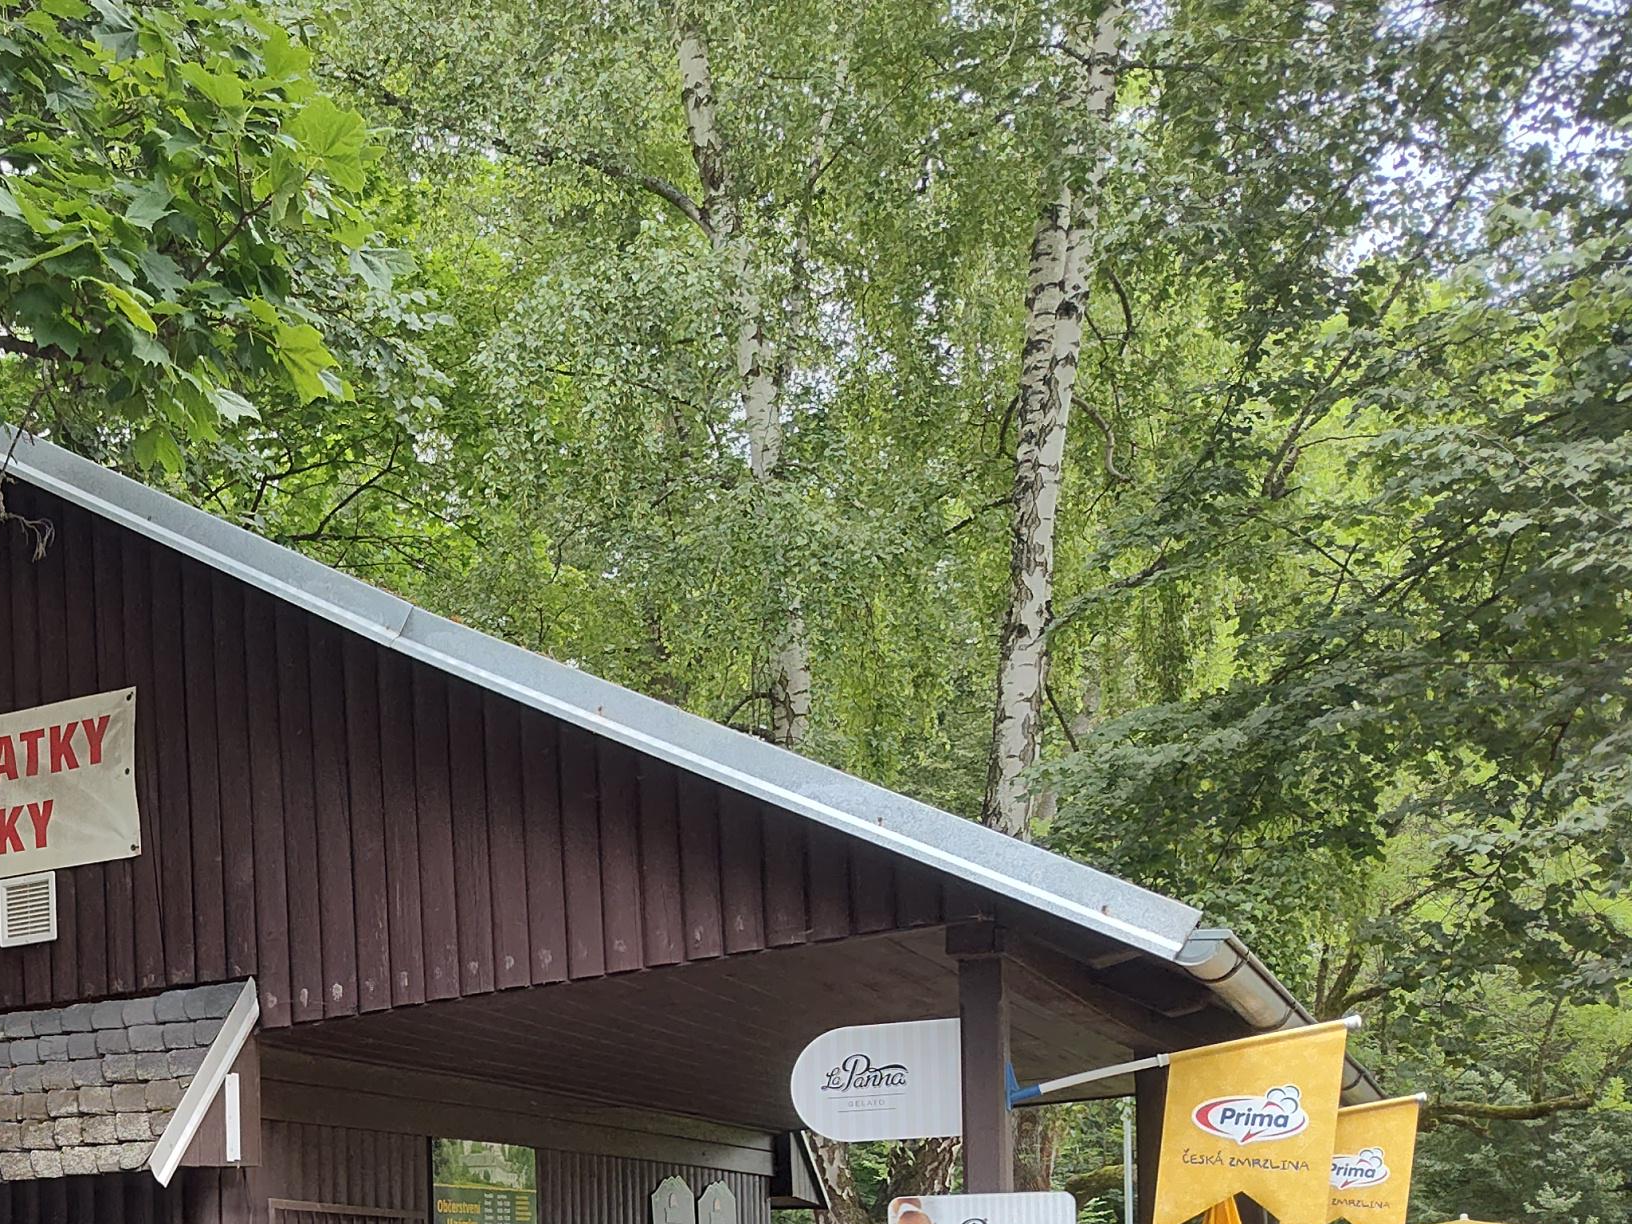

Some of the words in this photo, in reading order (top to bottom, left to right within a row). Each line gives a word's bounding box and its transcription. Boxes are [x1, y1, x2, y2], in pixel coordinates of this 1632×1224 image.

[821, 1066, 844, 1090] La
[841, 1053, 909, 1092] Panna
[847, 1099, 886, 1108] GELATO
[1219, 1107, 1289, 1128] Prima
[1182, 1148, 1224, 1166] ČESKÁ
[1229, 1157, 1310, 1171] ZMRZLINA
